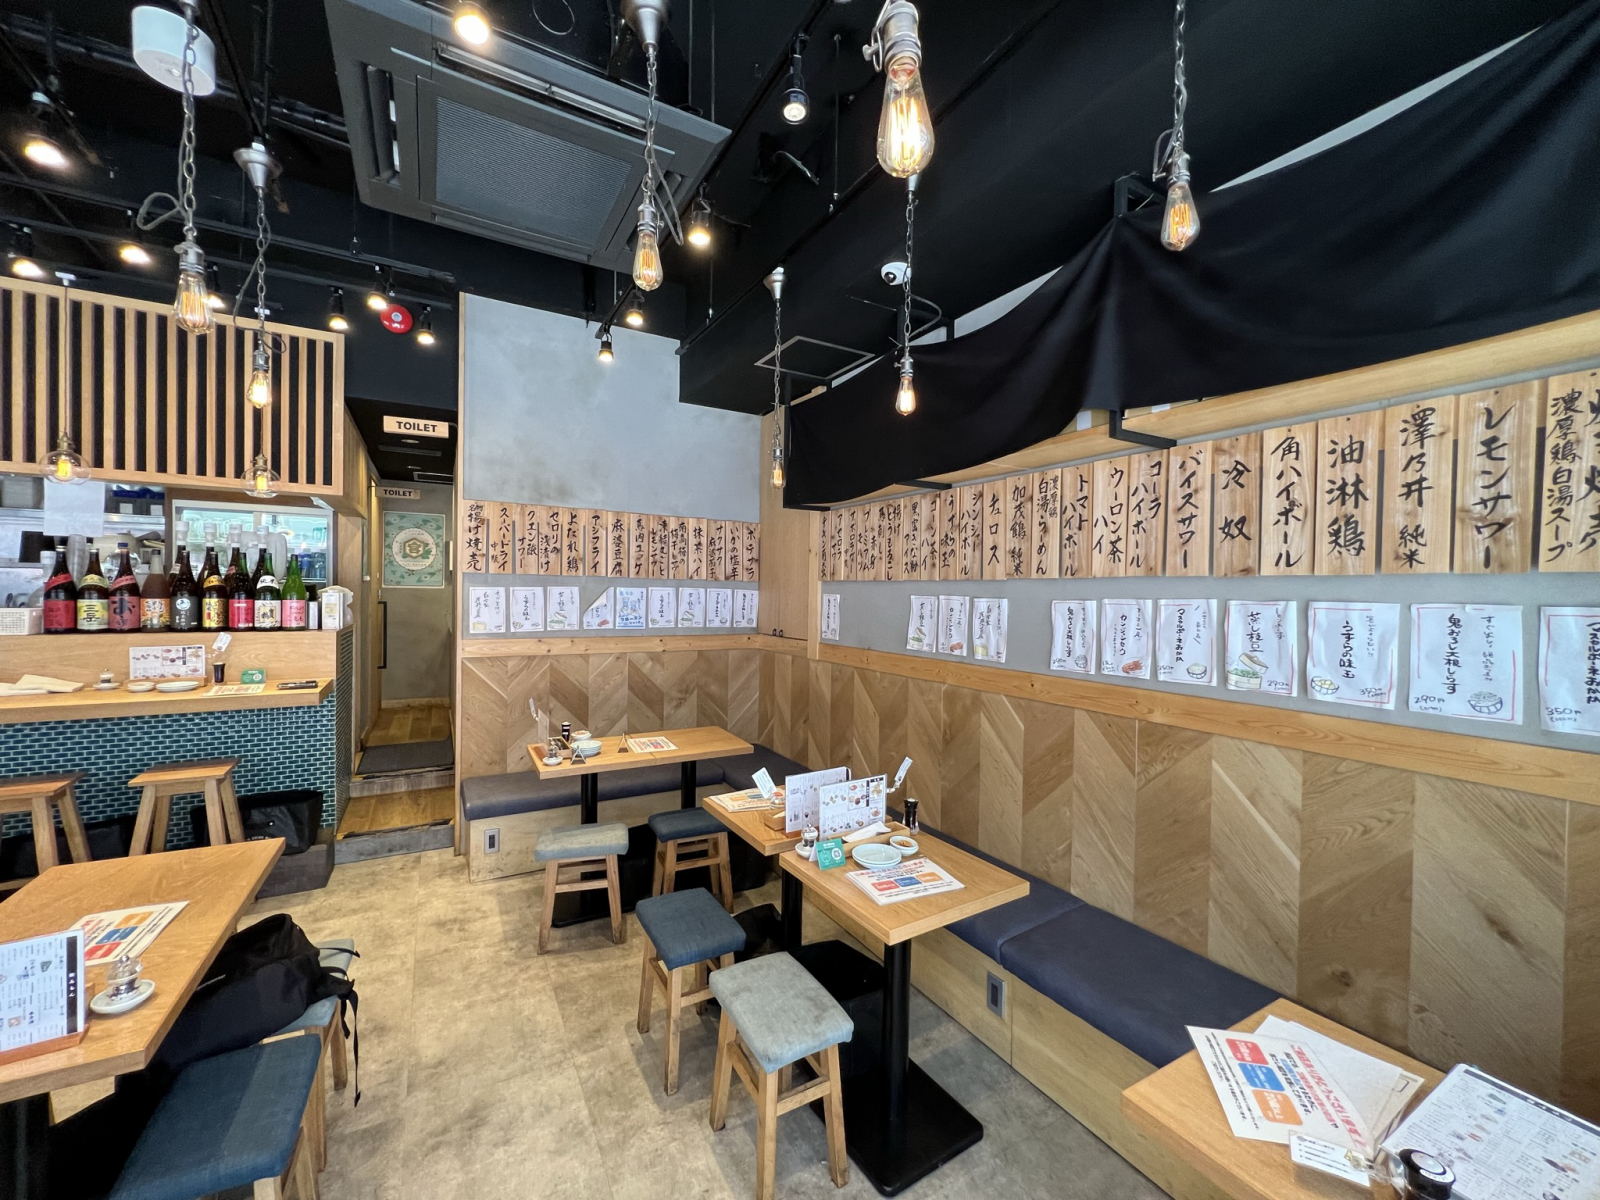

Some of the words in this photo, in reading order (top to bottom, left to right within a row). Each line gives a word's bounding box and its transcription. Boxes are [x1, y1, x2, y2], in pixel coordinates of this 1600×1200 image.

[396, 421, 438, 433] TOILET
[383, 489, 412, 497] TOILET
[1076, 474, 1089, 531] トマト
[1148, 460, 1161, 519] コーラ
[1218, 459, 1253, 544] 冷奴
[1270, 436, 1306, 568] 角ハイボール
[1325, 434, 1369, 557] 油淋鶏
[1471, 403, 1517, 569] レモンサワー
[1545, 388, 1584, 563] 濃厚鶏白湯スープ
[498, 507, 511, 571] スーパードライ
[550, 511, 561, 555] セロリの
[948, 494, 957, 559] うずらの
[987, 493, 1002, 567] チュロス
[1035, 477, 1050, 576] 白湯らーめん
[1092, 515, 1108, 555] ハイ
[1107, 467, 1125, 564] ウーロン茶
[1129, 483, 1148, 568] ハイボール
[1176, 449, 1200, 570] バイスサワー
[517, 536, 526, 569] サワー
[540, 534, 551, 573] 浅漬け
[566, 511, 579, 573] よだれ鶏
[610, 518, 625, 577] 麻婆豆腐
[692, 526, 704, 577] 抹茶ハイ
[730, 527, 740, 580] いかの塩辛
[903, 533, 911, 574] アイス
[922, 538, 930, 571] ハイ
[960, 510, 971, 576] ハイボール
[1063, 502, 1077, 577] ハイボール
[1246, 611, 1265, 653] 蒸し枝豆
[1339, 620, 1357, 679] うずらの味玉
[1442, 613, 1463, 695] 鬼おろし大根しらす
[1413, 694, 1445, 704] 290円
[1545, 707, 1582, 716] 350円
